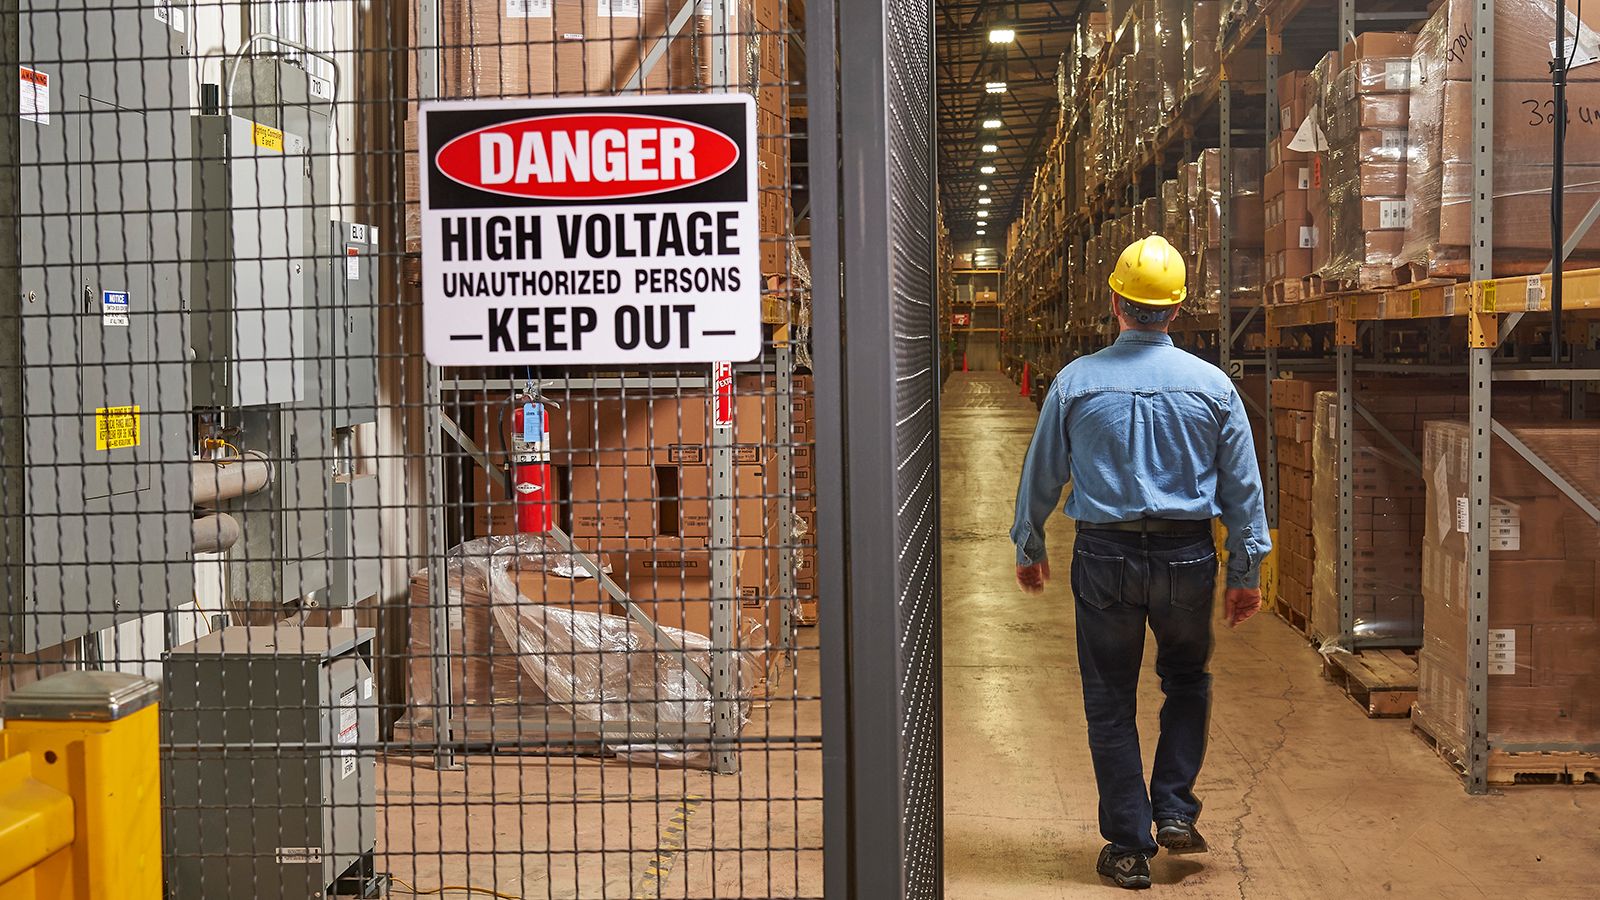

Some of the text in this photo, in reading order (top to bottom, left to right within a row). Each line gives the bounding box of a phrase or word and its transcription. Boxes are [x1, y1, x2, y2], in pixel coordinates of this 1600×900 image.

[479, 127, 697, 185] DANGER
[441, 210, 741, 261] HIGH VOLTAGE
[109, 293, 125, 304] NOTICE
[443, 266, 741, 298] UNAUTHORIZED PERSONS
[487, 305, 696, 353] KEEP OUT
[1230, 362, 1241, 379] 2
